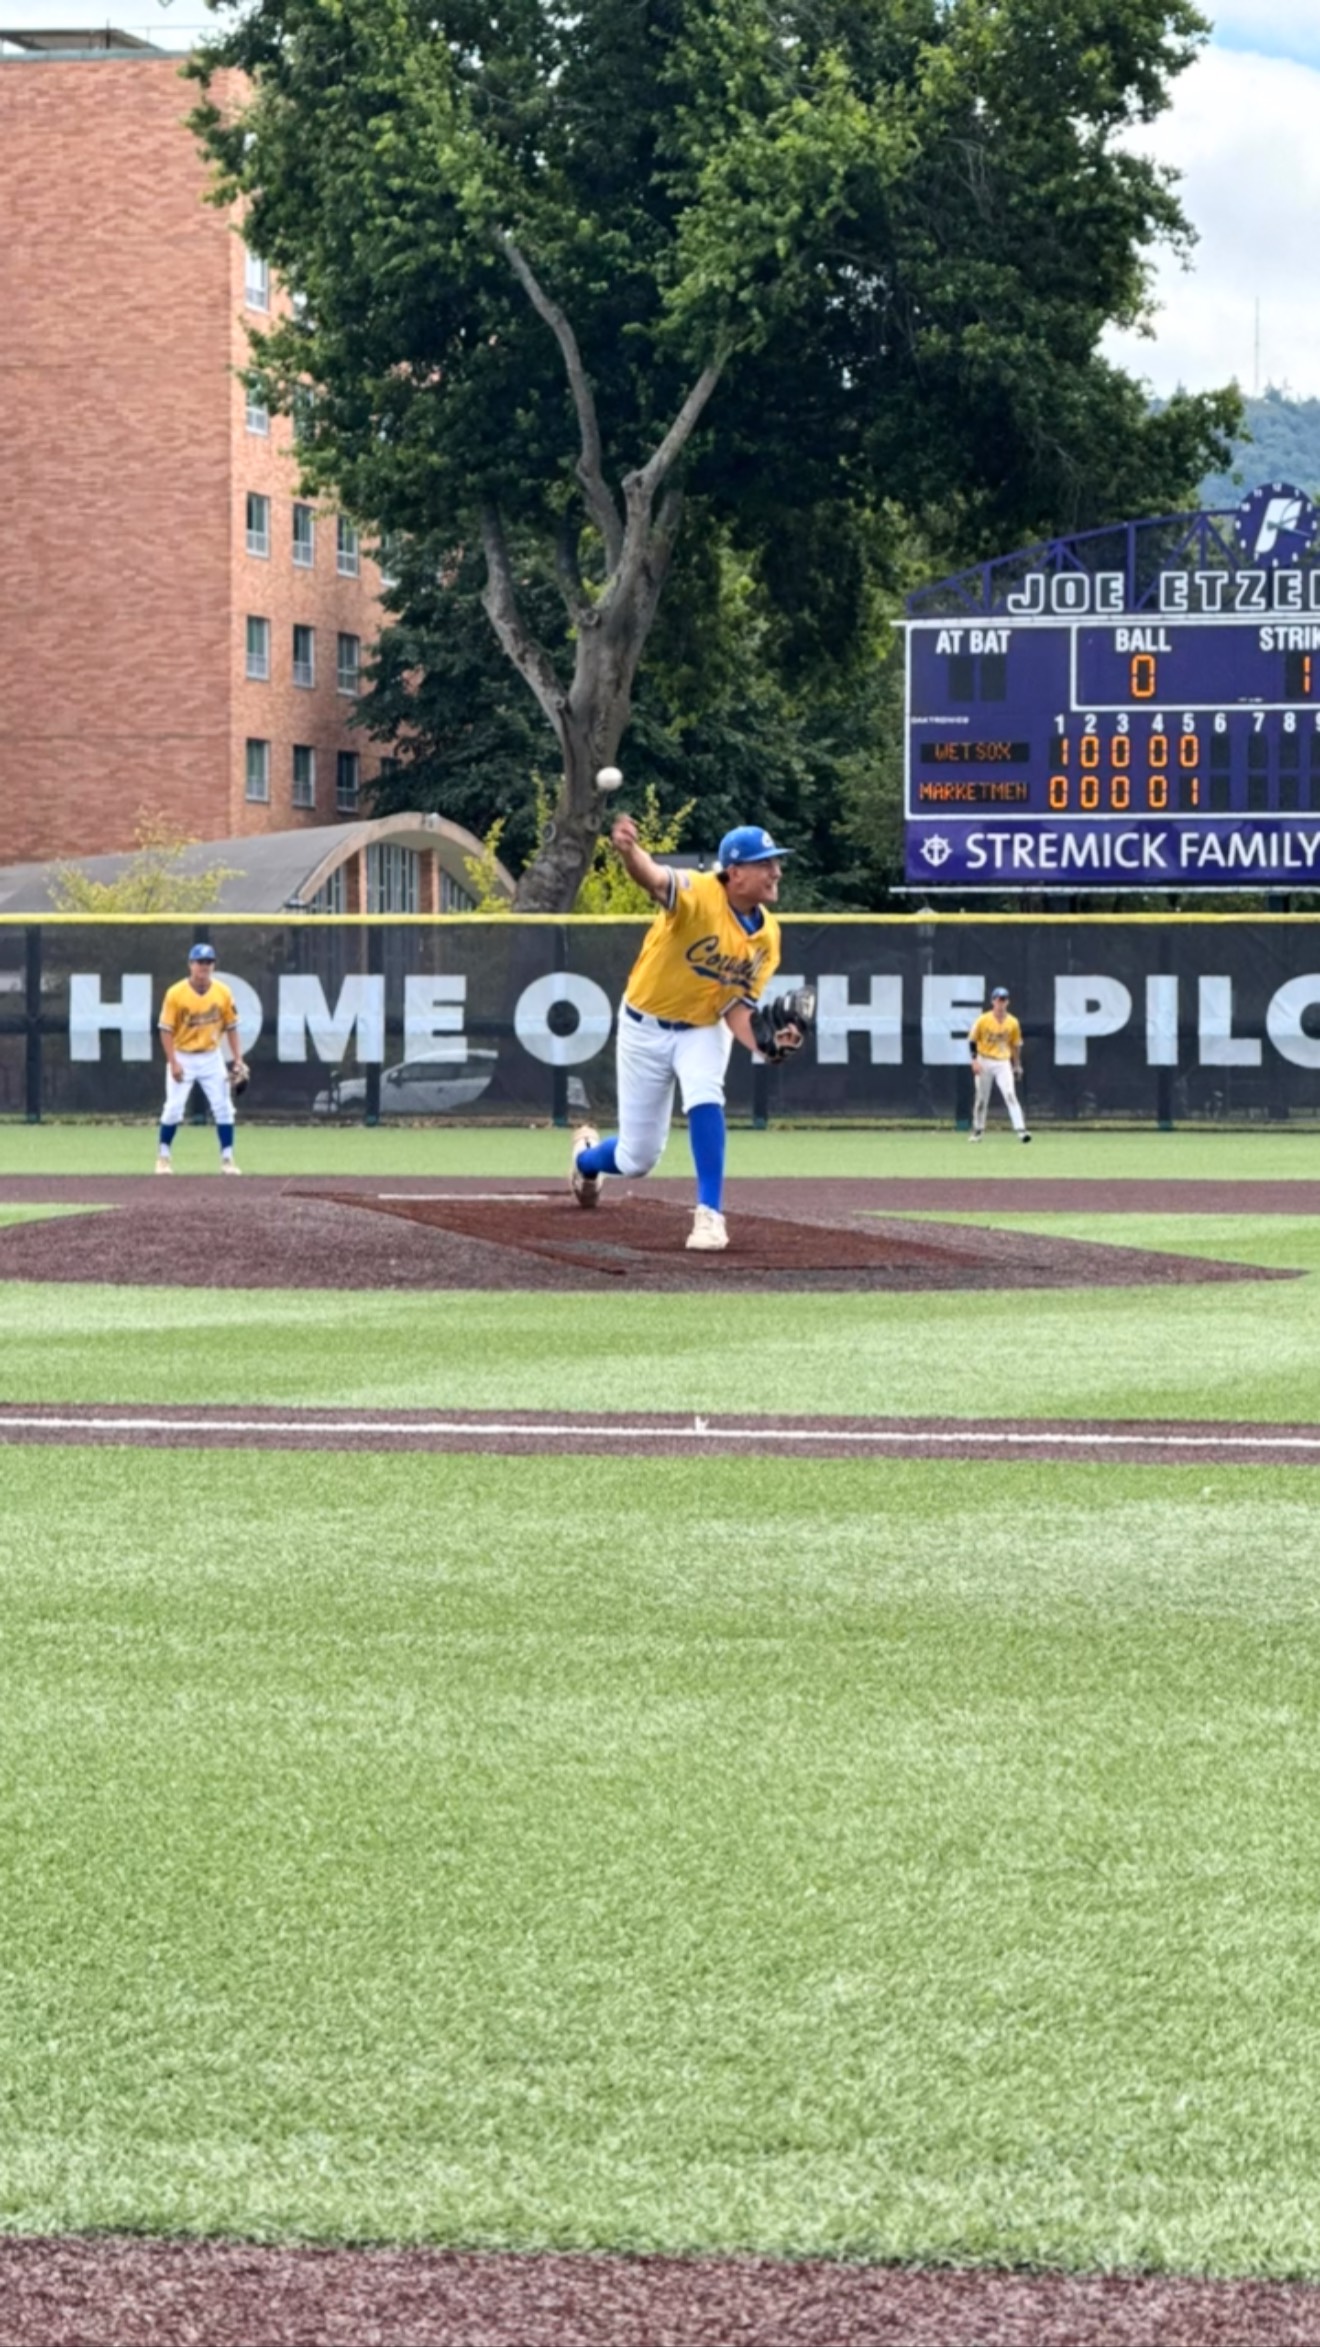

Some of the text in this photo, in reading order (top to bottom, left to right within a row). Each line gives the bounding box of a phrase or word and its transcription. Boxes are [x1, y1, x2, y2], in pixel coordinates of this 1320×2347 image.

[1007, 572, 1125, 613] JOE
[935, 629, 1011, 654] AT BAT
[1115, 628, 1172, 653] BALL
[1130, 654, 1156, 698] 0
[1303, 655, 1311, 693] 1
[1054, 714, 1065, 735] 1
[1084, 713, 1097, 733] 2
[1117, 713, 1129, 733] 3
[1152, 713, 1164, 732] 4
[1182, 713, 1195, 732] 5
[1214, 713, 1227, 732] 6
[1253, 712, 1265, 732] 7
[1284, 712, 1296, 732] 8
[934, 734, 1199, 768] WET SOX 1 0 0 0 0
[919, 775, 1199, 809] MARKETMEN 0 0 0 0 1
[965, 831, 1320, 868] STREMICK FAMILY
